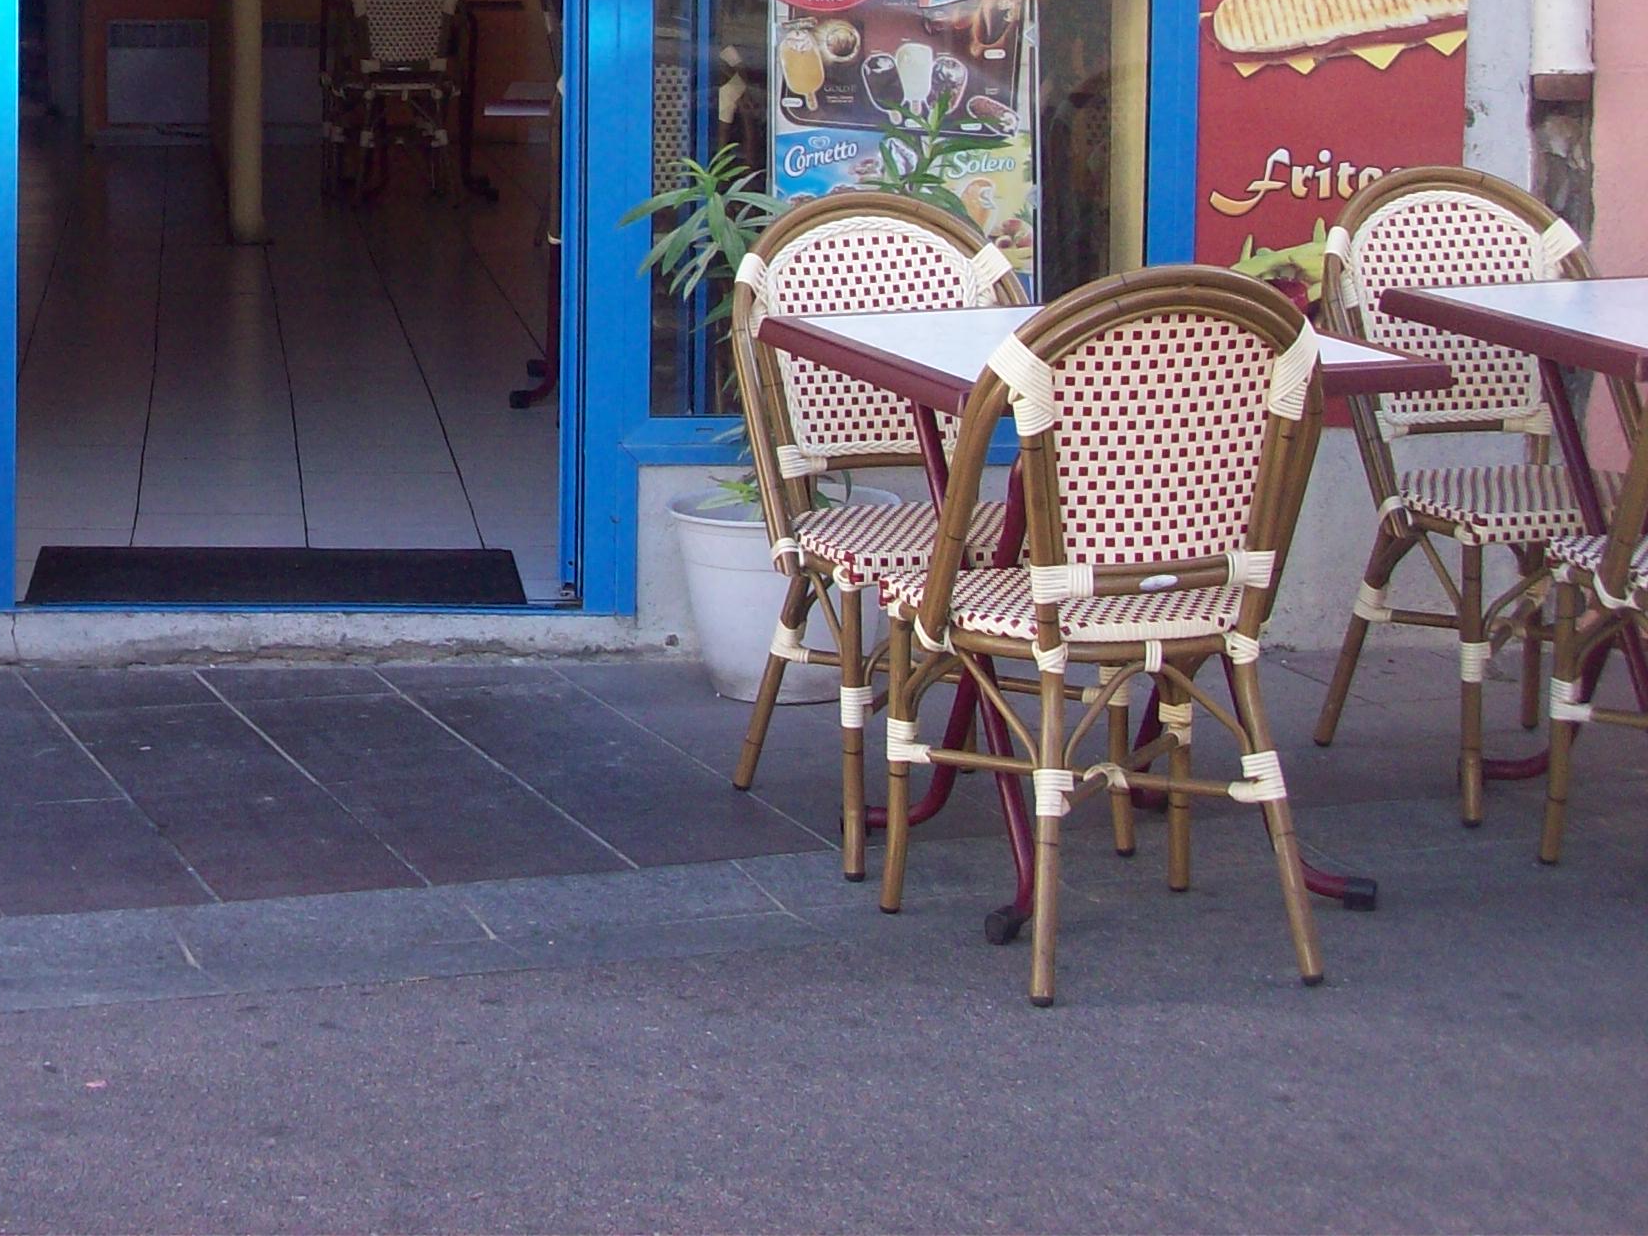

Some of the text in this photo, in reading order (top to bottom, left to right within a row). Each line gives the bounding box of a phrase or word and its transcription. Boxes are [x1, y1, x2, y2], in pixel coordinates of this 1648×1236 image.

[783, 139, 859, 177] Cornetto
[946, 148, 1016, 179] Solero
[1209, 147, 1406, 216] Frite
